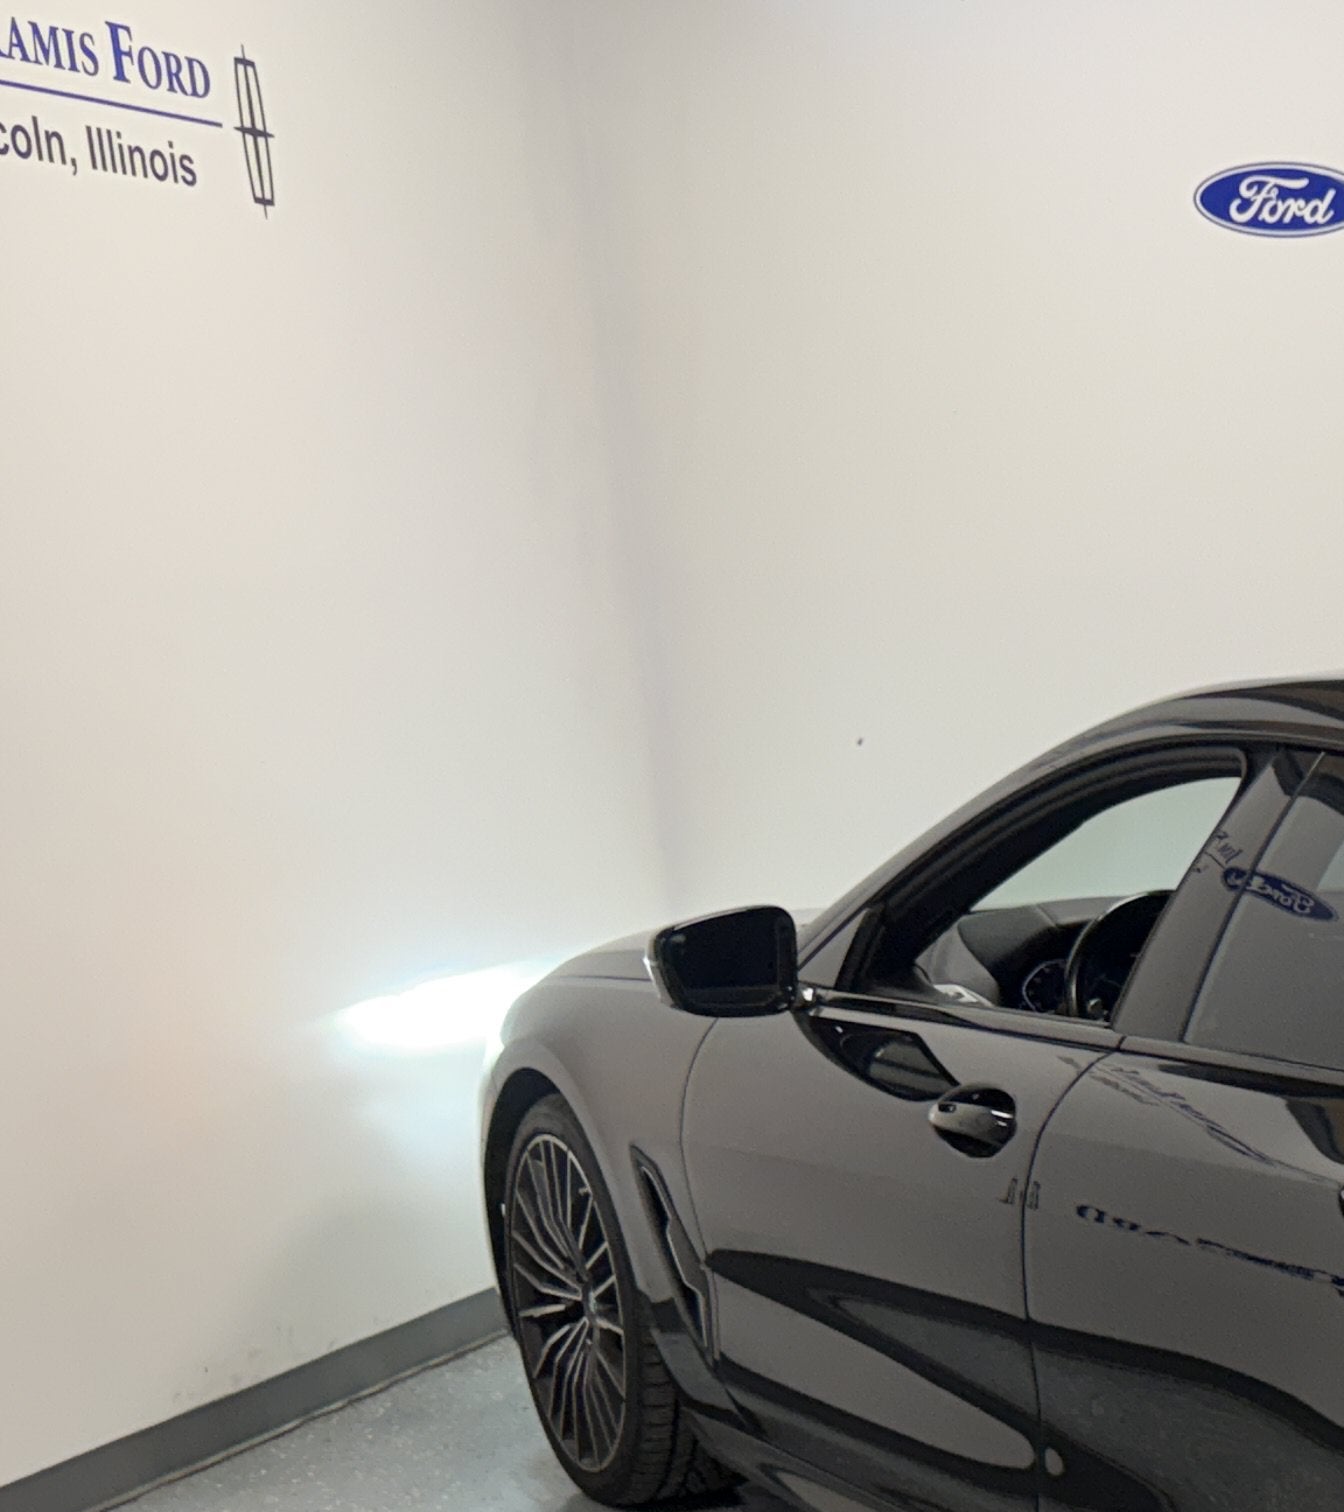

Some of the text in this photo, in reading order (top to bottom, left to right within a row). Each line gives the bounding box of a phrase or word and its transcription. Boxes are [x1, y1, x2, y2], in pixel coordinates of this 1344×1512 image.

[0, 16, 211, 99] AMIS FORD
[86, 124, 198, 187] Illinois
[1228, 175, 1335, 224] Ford
